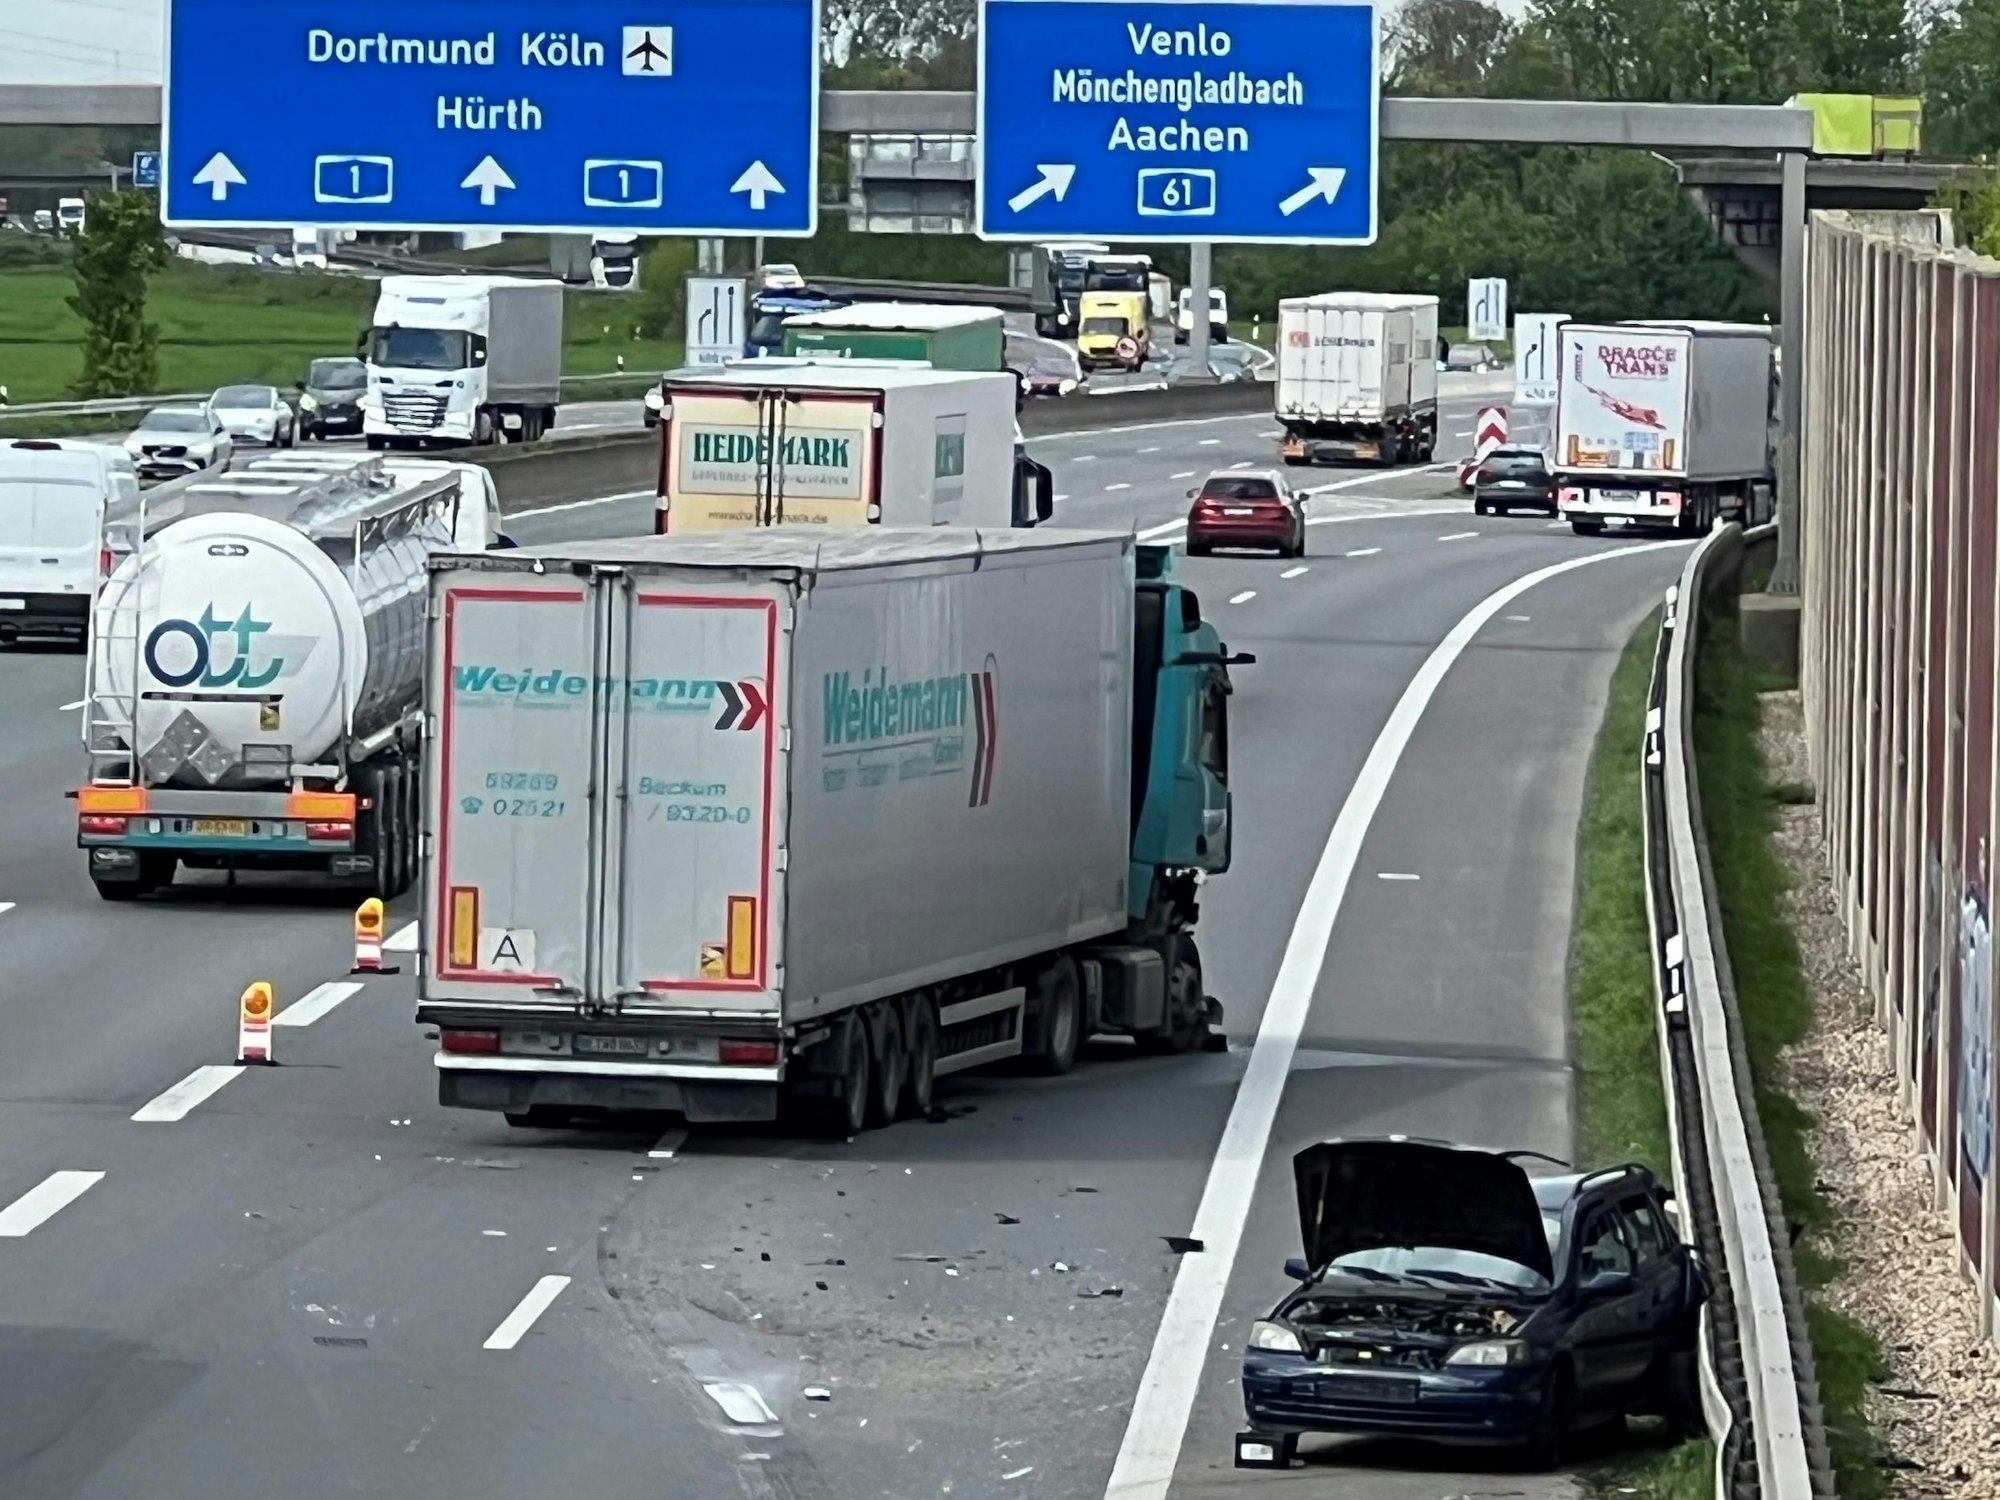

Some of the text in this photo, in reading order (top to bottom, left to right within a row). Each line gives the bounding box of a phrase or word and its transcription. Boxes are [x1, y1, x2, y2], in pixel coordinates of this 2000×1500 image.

[308, 30, 604, 66] Dortmund Köln
[1127, 22, 1231, 57] Venlo
[1053, 69, 1303, 112] Mönchengladbach
[437, 95, 542, 130] Hürth
[1108, 117, 1249, 152] Aachen
[350, 165, 359, 194] 1
[619, 169, 629, 198] 1
[1163, 178, 1191, 206] 61
[453, 665, 718, 699] Weidemann
[823, 666, 968, 744] Weidemann
[491, 933, 522, 966] A
